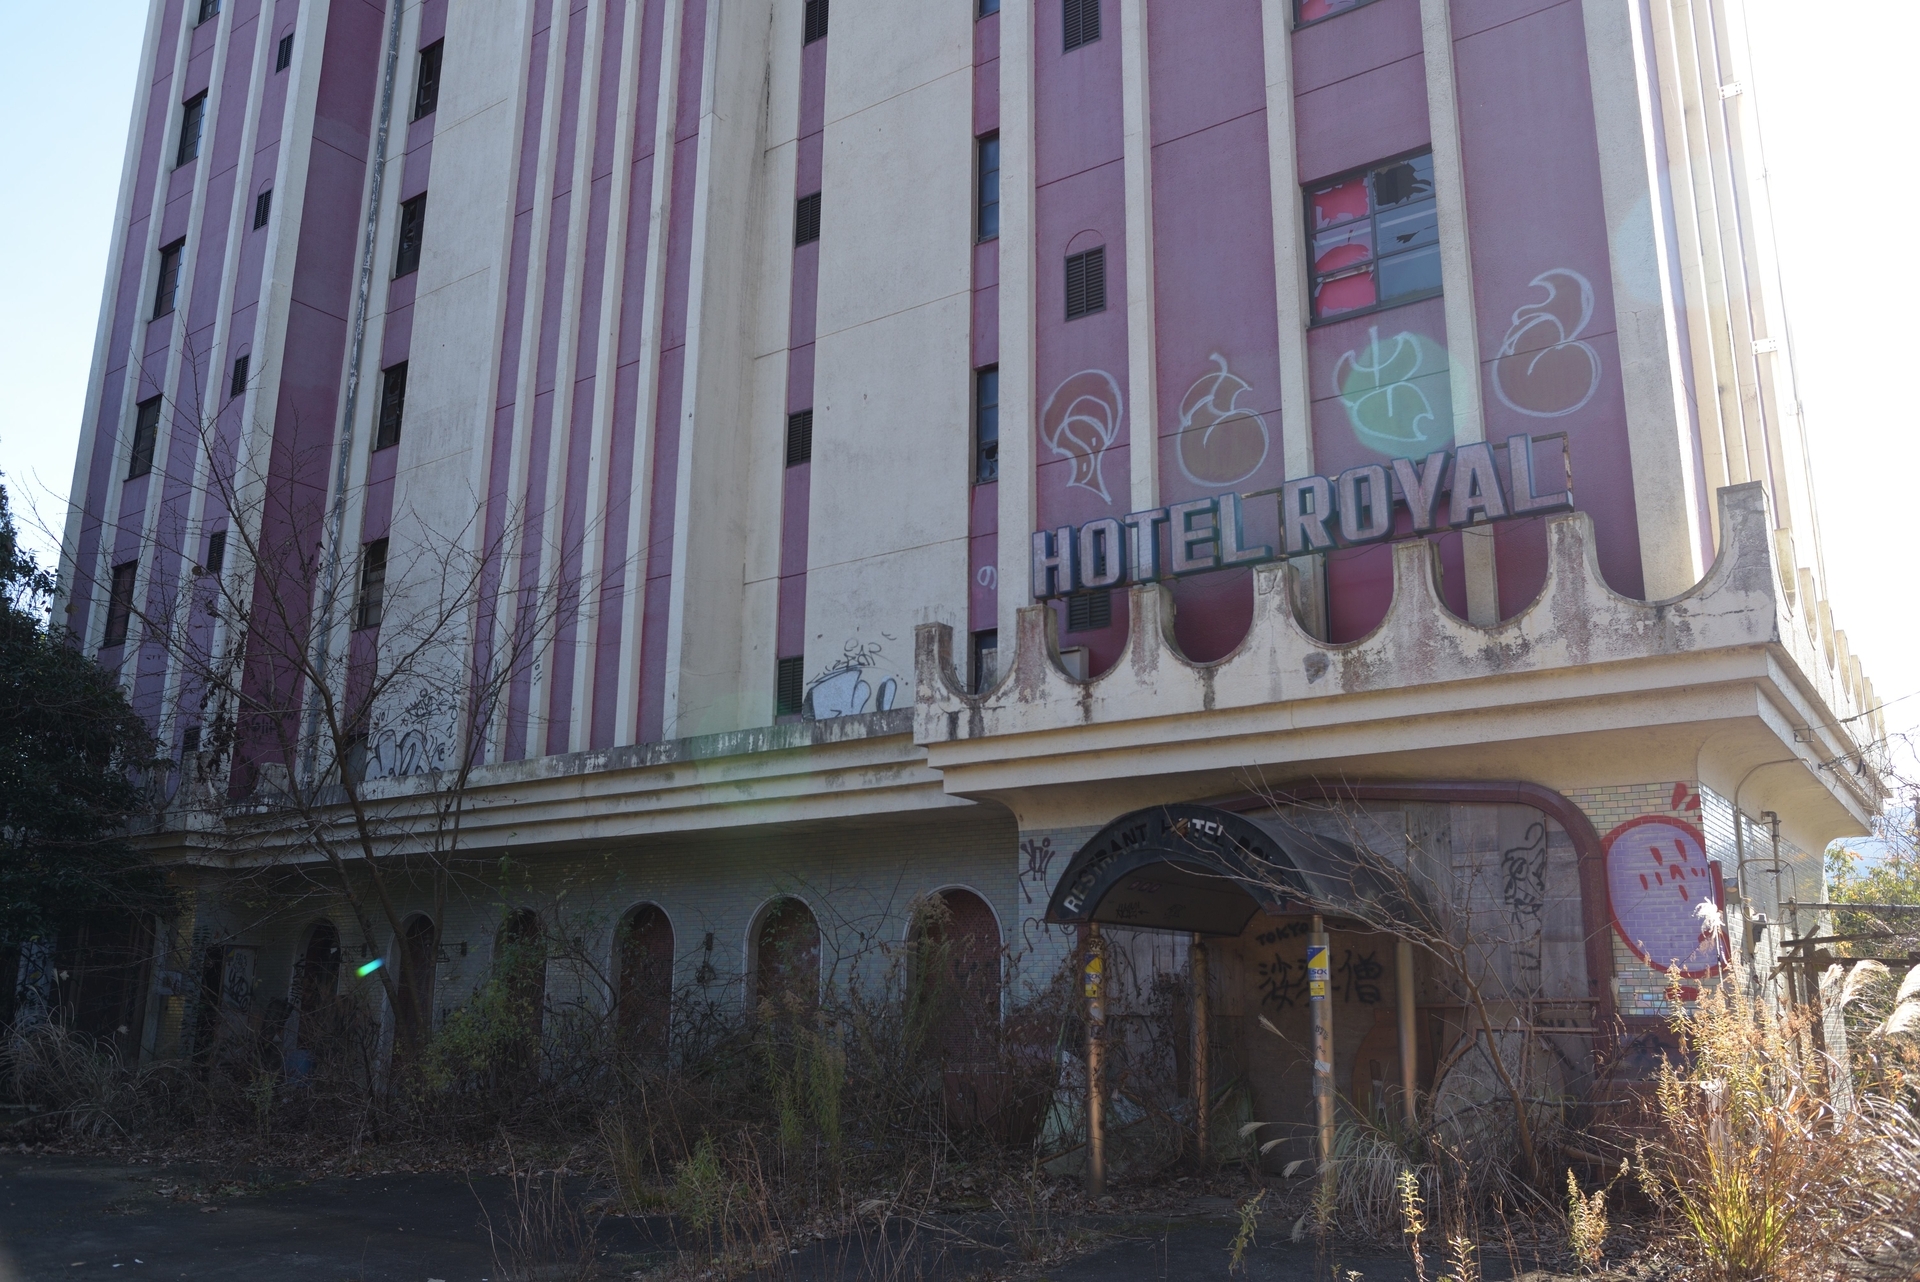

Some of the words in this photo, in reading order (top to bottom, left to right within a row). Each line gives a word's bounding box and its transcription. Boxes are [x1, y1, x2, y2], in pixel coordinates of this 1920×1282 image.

[1032, 492, 1272, 600] HOTEL
[1281, 432, 1574, 553] ROYAL
[1161, 817, 1224, 848] HTEL
[1256, 922, 1309, 946] TOKYO
